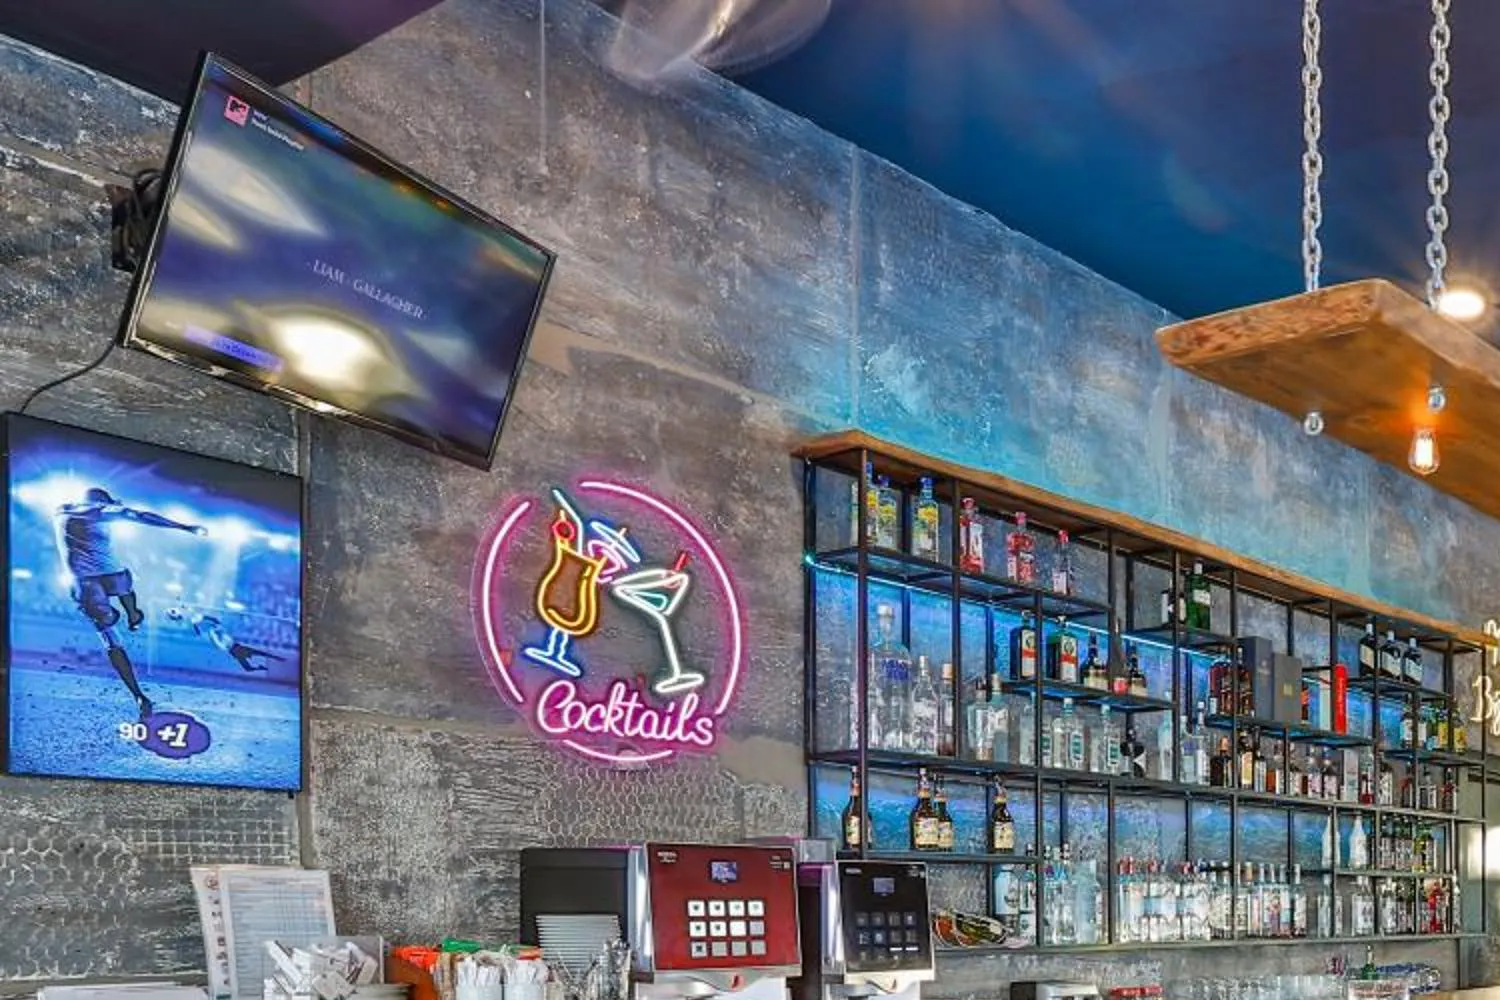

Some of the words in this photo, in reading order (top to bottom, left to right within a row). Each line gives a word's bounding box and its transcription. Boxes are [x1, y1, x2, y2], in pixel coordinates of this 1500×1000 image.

[313, 259, 345, 284] LIAM
[353, 279, 423, 319] GALLAGHER
[119, 722, 147, 741] 90
[157, 723, 188, 747] +1
[537, 680, 714, 746] Cocktails
